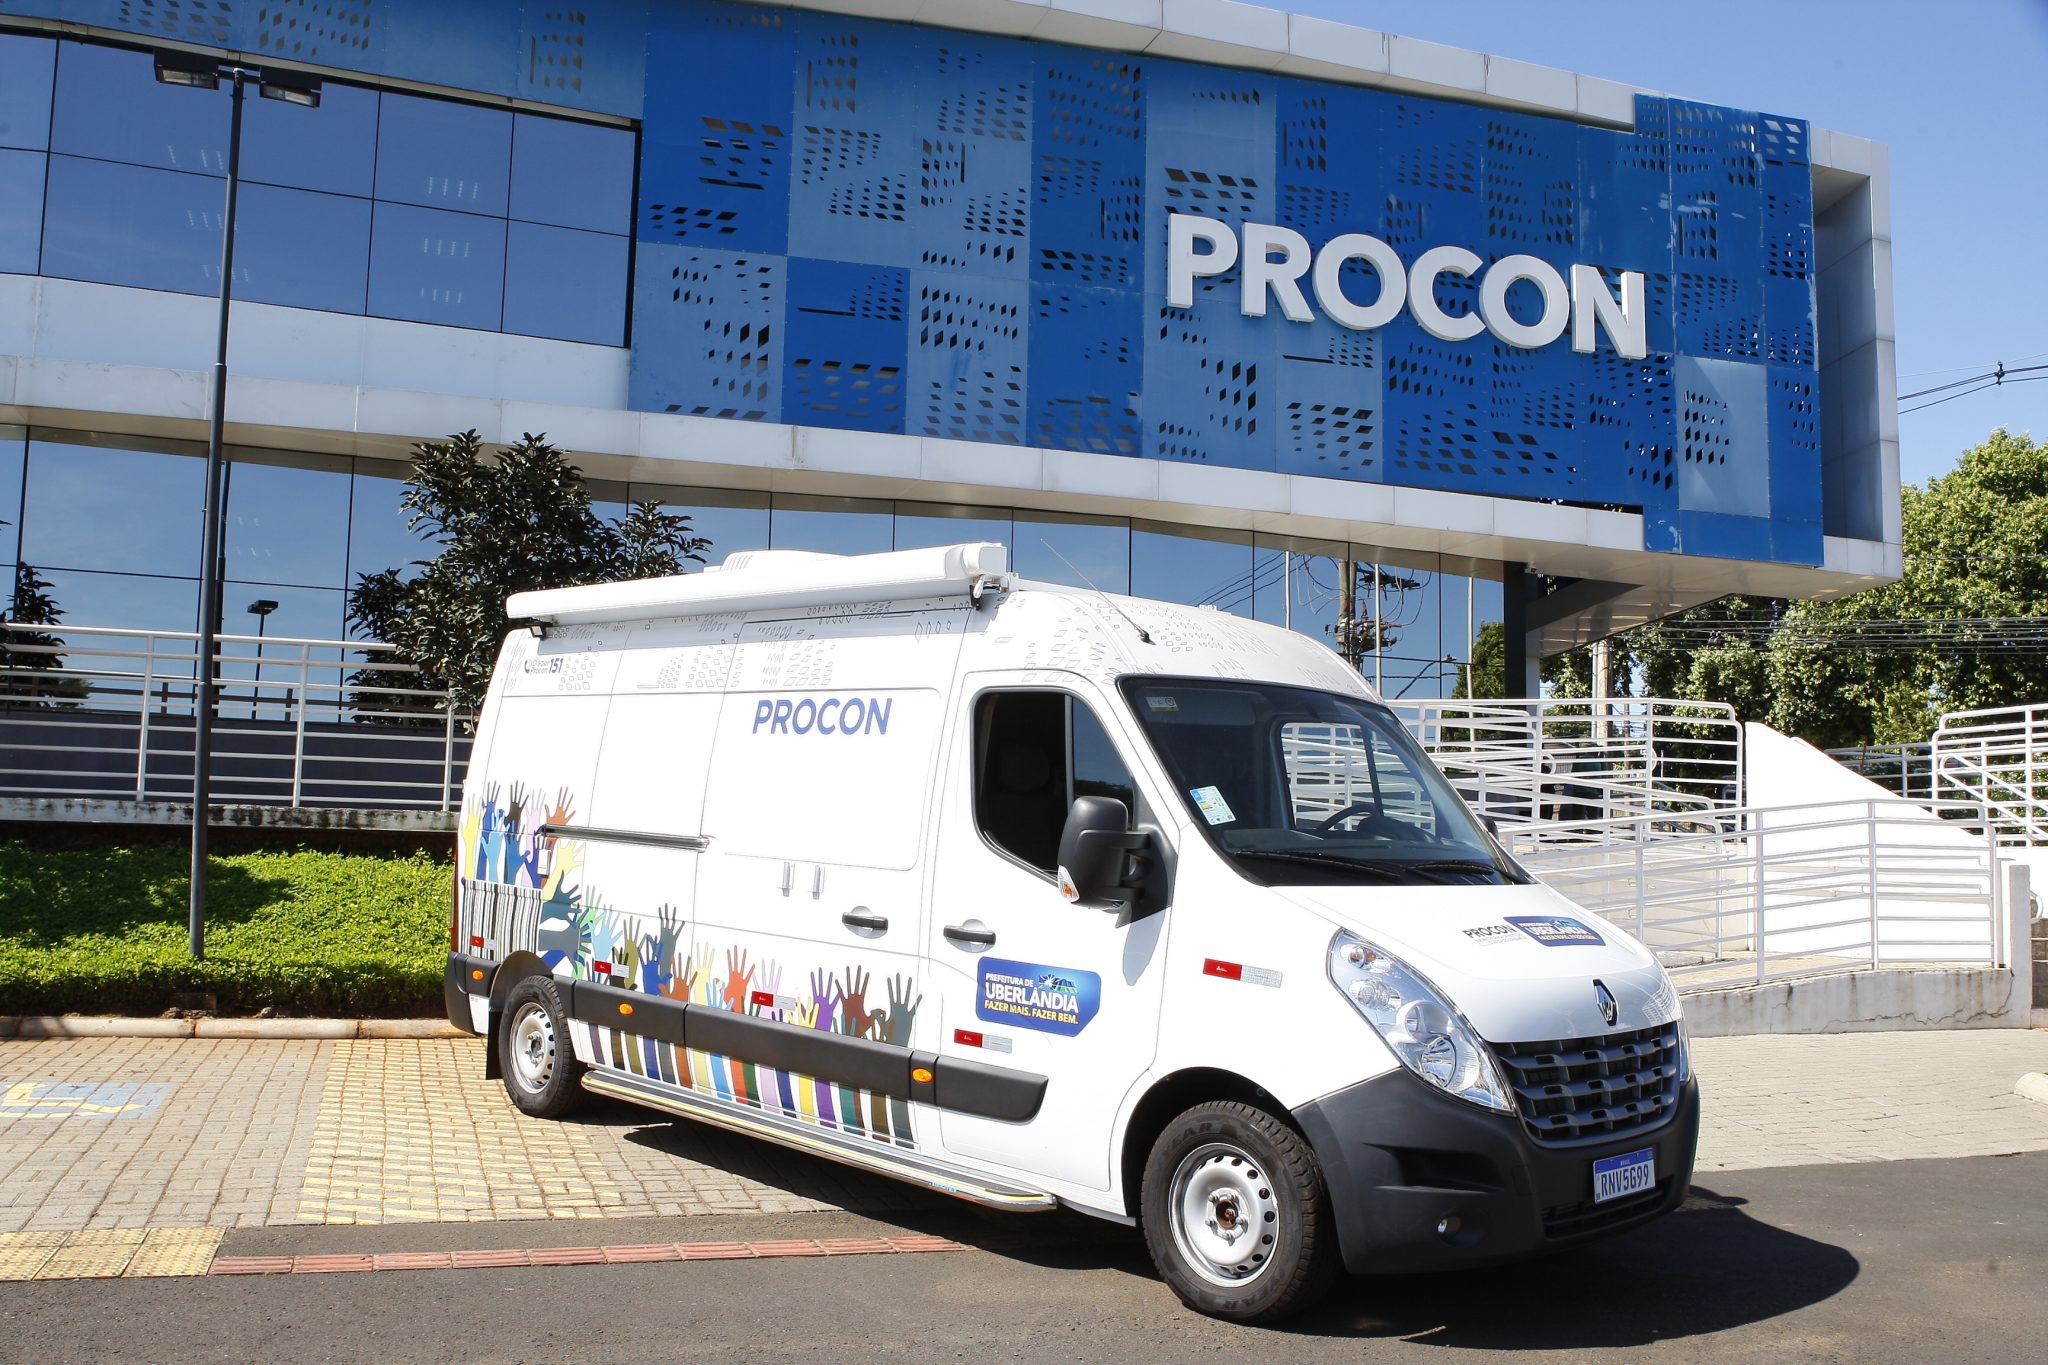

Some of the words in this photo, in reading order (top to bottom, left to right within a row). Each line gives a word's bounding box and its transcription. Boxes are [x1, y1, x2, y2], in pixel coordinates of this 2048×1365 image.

[1167, 213, 1647, 360] PROCON
[549, 658, 564, 674] 151
[752, 698, 893, 735] PROCON
[1462, 924, 1518, 939] PROCON
[985, 973, 1024, 986] PREFEITURA
[1025, 979, 1034, 988] DE
[985, 982, 1079, 1013] UBERLÂNDIA
[984, 1000, 1009, 1012] FAZER
[1010, 1003, 1031, 1017] MAIS.
[1032, 1009, 1057, 1021] FAZER
[1058, 1012, 1079, 1025] BEM.
[1601, 1163, 1649, 1197] RNV5G99
